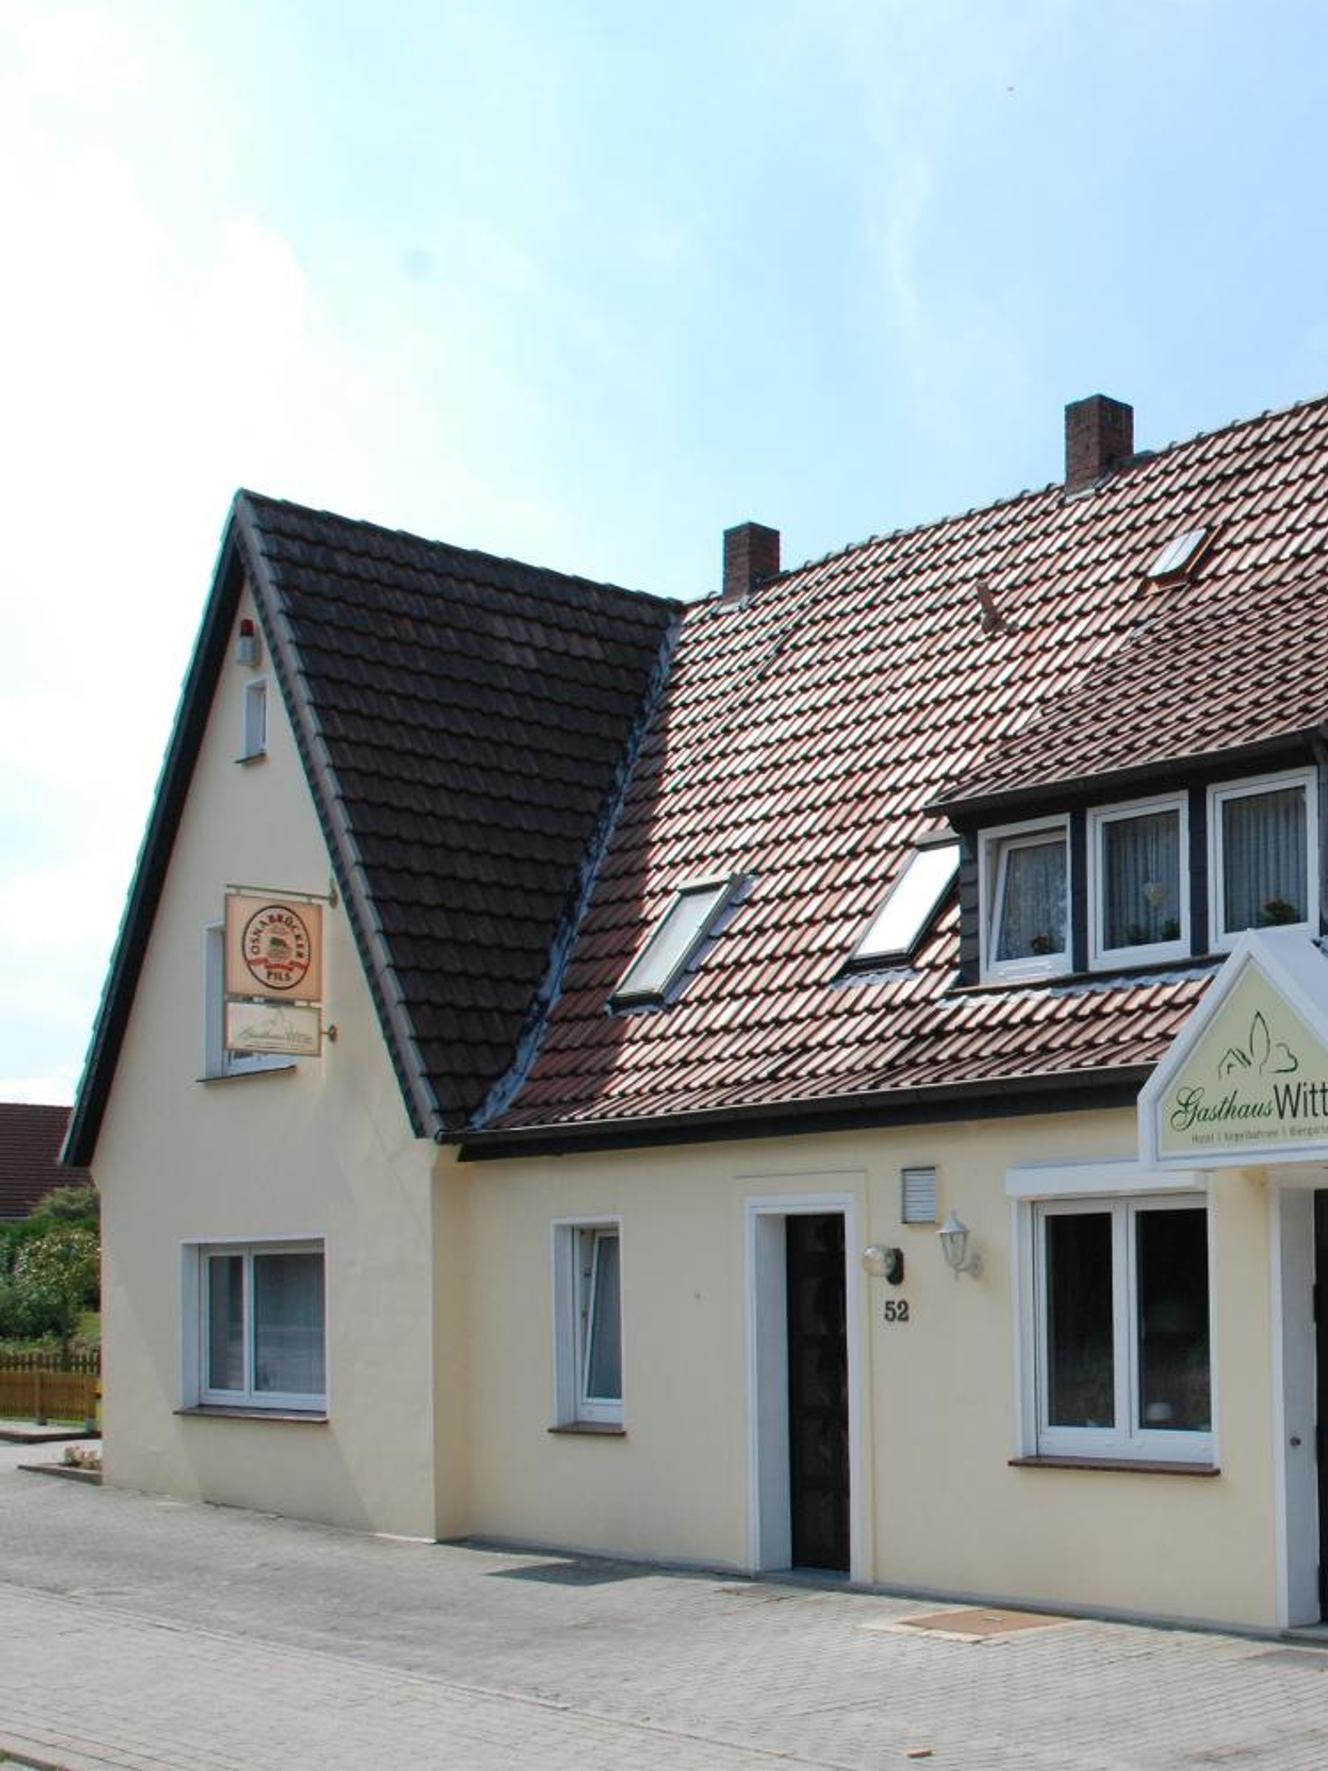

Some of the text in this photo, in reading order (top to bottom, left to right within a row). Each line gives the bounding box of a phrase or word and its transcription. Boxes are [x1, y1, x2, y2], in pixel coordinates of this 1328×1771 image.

[266, 971, 292, 981] PILS
[1170, 1086, 1274, 1132] Gasthaus
[885, 1299, 909, 1322] 52
